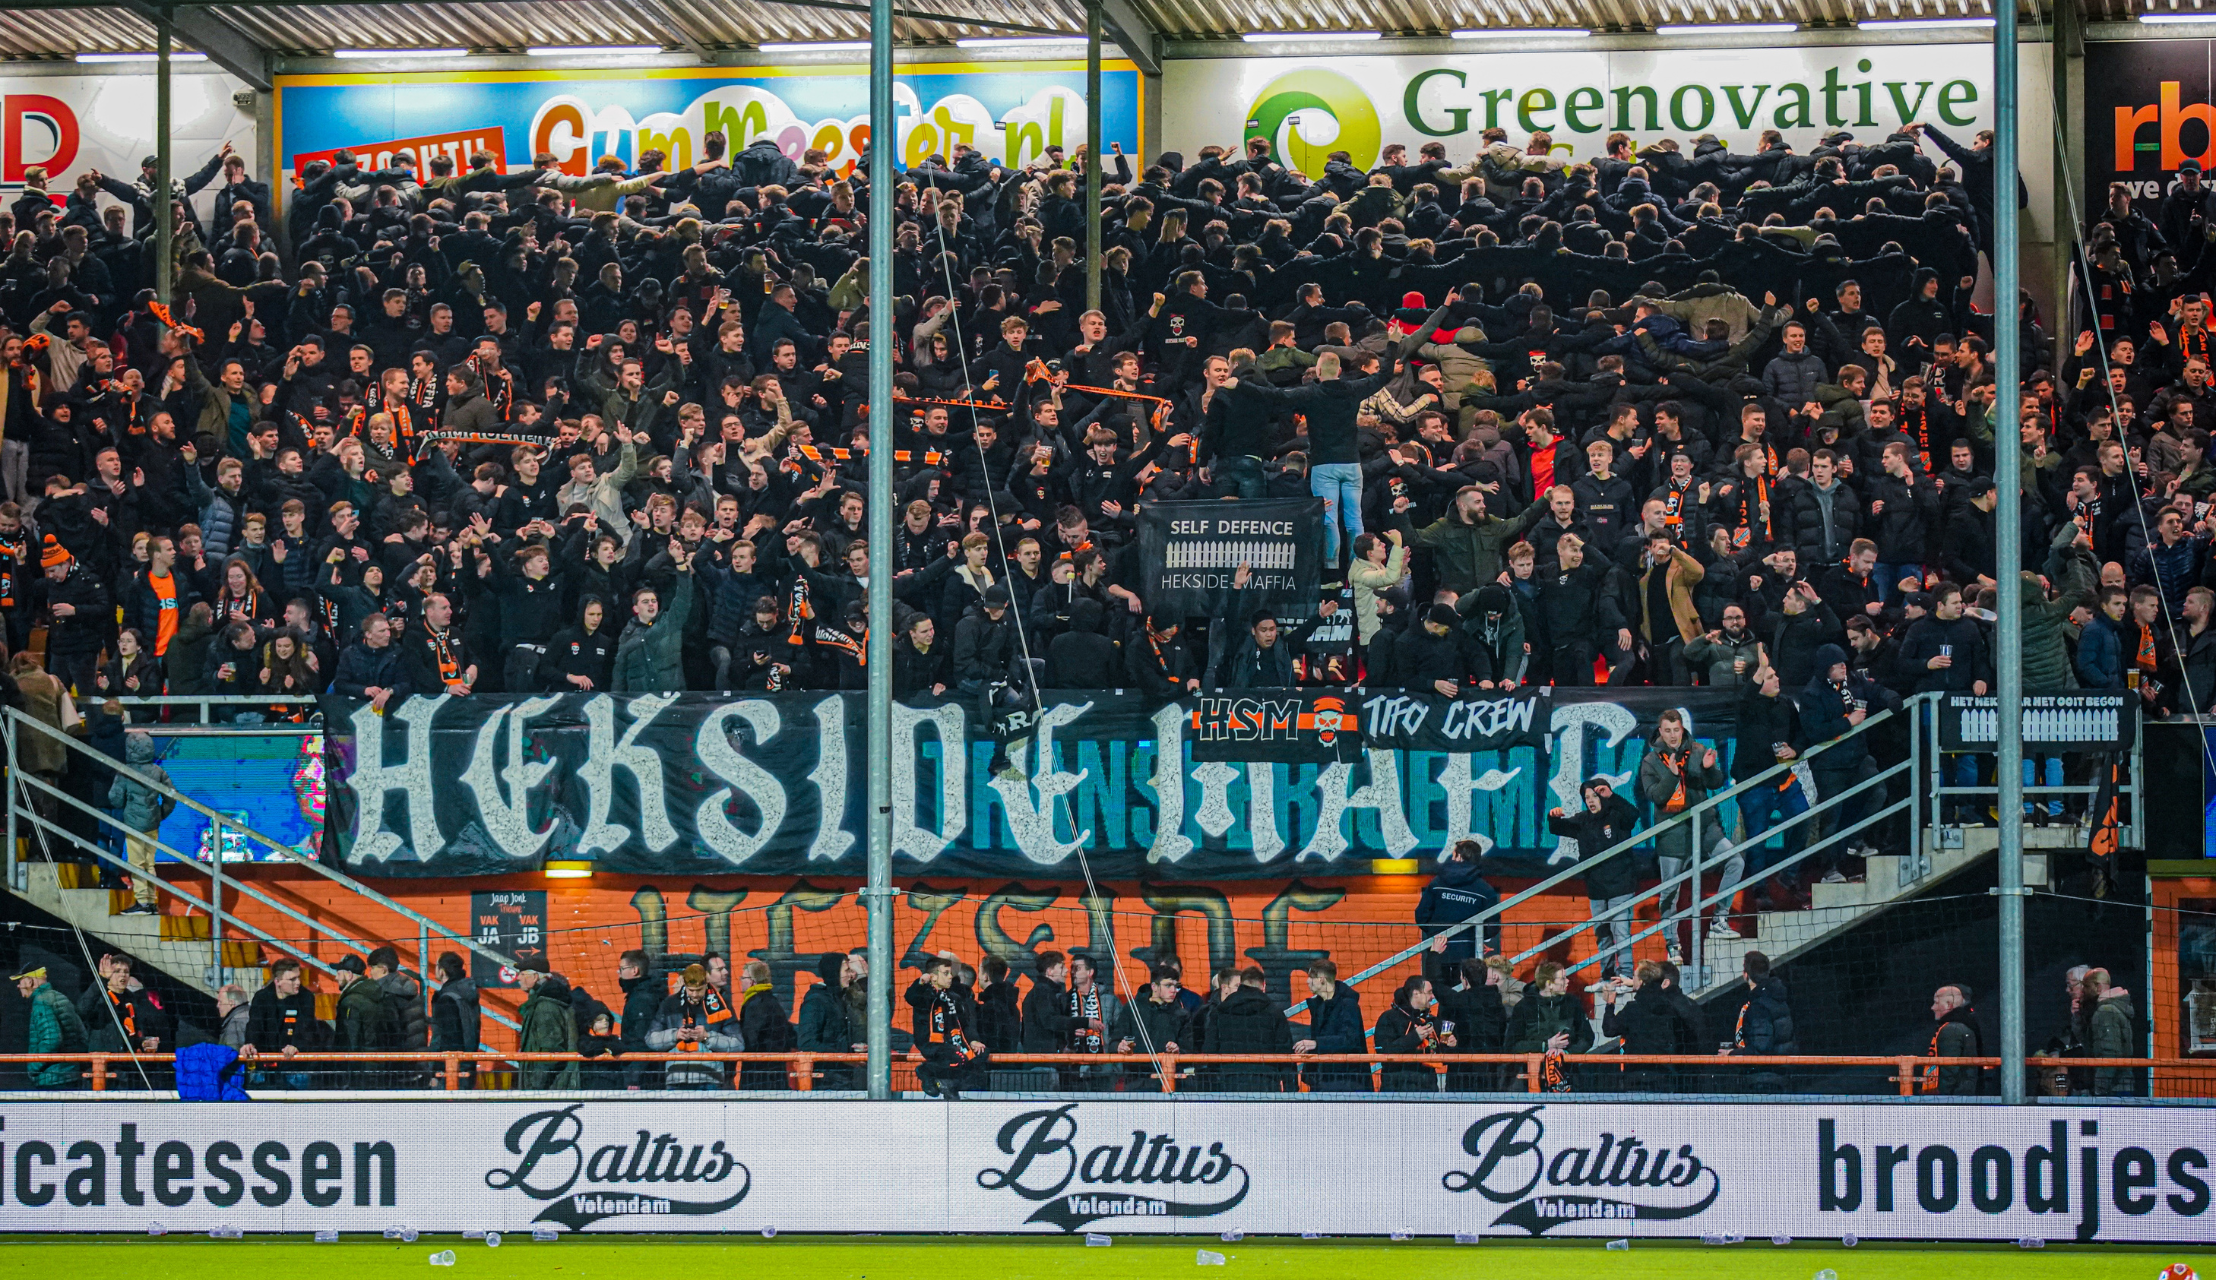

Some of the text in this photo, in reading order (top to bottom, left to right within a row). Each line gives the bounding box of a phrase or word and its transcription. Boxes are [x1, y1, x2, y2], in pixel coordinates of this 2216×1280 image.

[1403, 59, 1978, 137] Greenovative
[1170, 520, 1294, 535] SELF DEFENCE
[1950, 696, 1973, 707] HET
[2033, 697, 2055, 707] HET
[2057, 696, 2083, 707] OOIT
[2085, 696, 2124, 707] BEGON
[1199, 698, 1302, 741] HSM
[1362, 695, 1537, 739] TIFO CREW
[346, 692, 1094, 866] HEKSIDE
[1146, 701, 1820, 866] MAFF
[489, 893, 509, 906] Jaap
[1441, 892, 1477, 905] SECURITY
[480, 915, 499, 925] VAK
[519, 915, 539, 925] VAK
[478, 927, 500, 944] JA
[517, 927, 540, 944] JB
[486, 1103, 750, 1200] Baltus
[977, 1103, 1249, 1201] Baltus
[1442, 1104, 1720, 1203] Baltus
[1818, 1118, 2212, 1241] broodjes
[573, 1195, 671, 1214] Volendam
[1067, 1195, 1167, 1216] Volendam
[1533, 1199, 1636, 1219] Volendam
